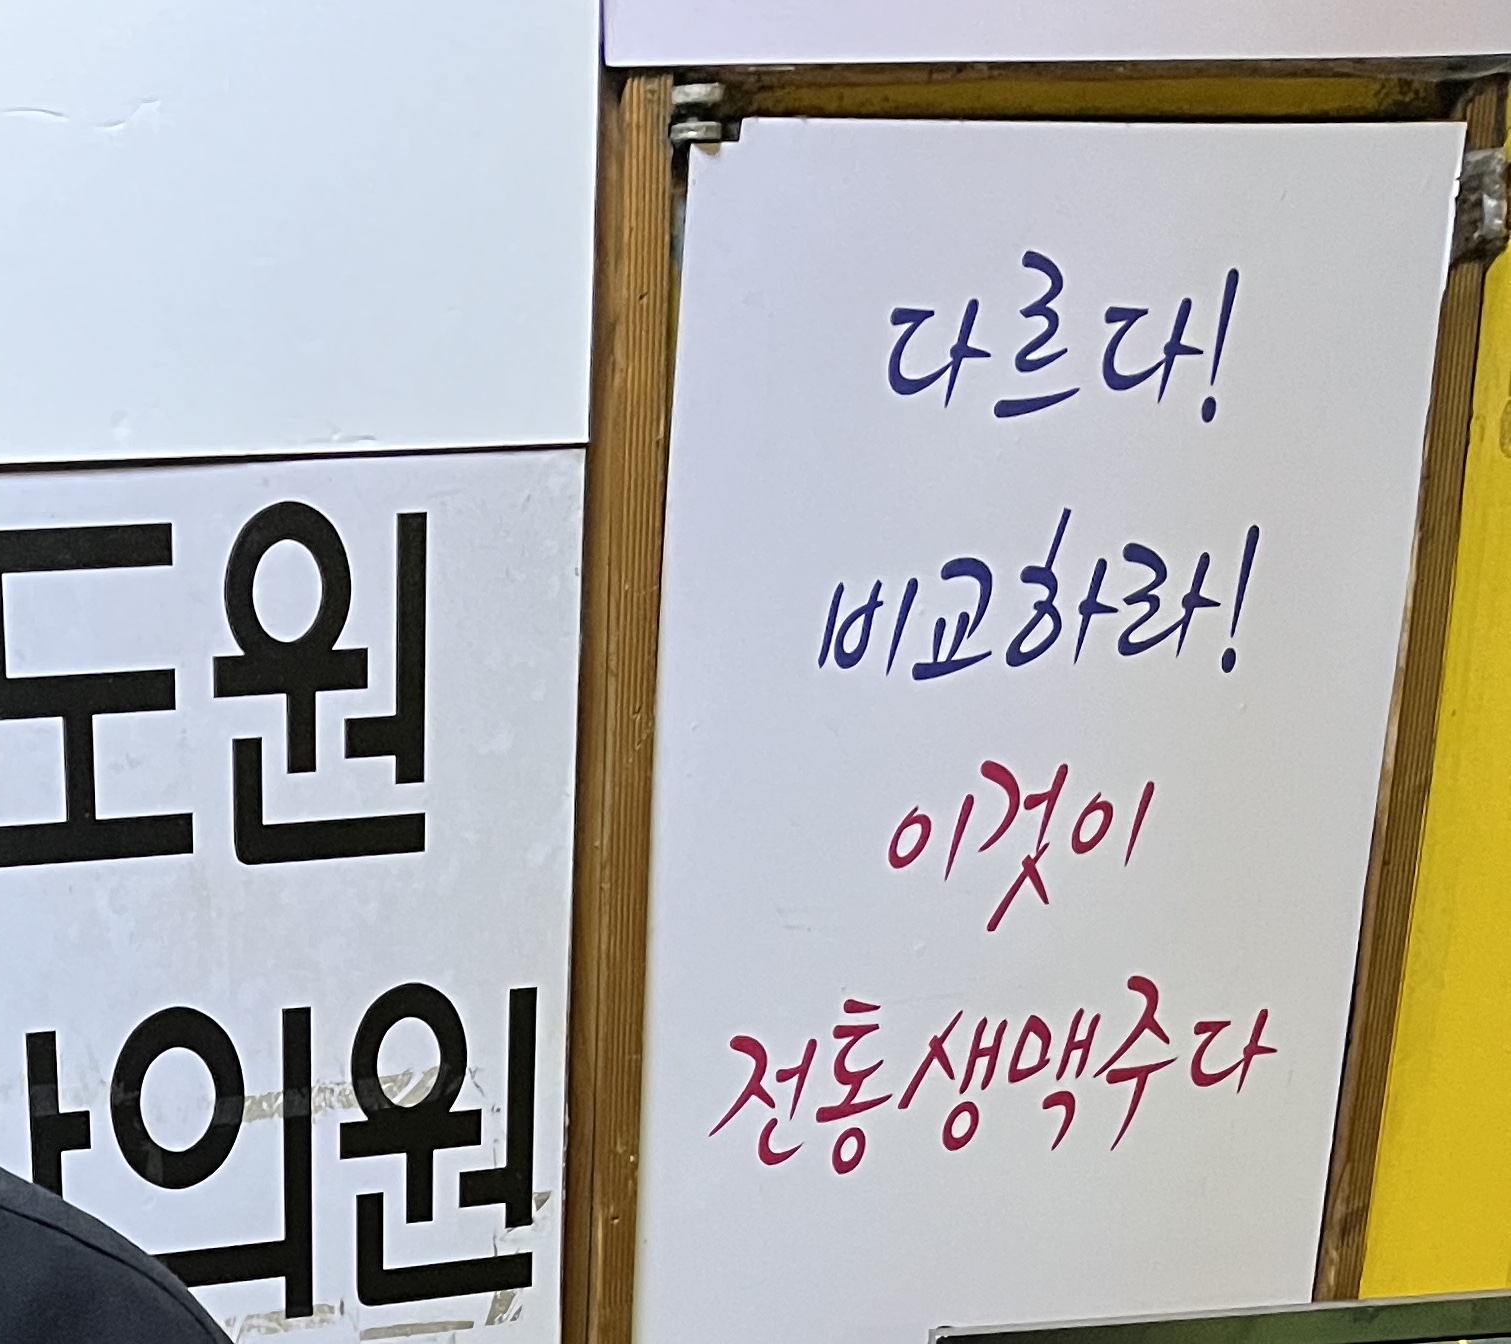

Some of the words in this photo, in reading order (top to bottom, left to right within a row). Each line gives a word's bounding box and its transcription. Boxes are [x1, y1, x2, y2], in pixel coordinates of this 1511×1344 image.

[888, 251, 1239, 422] 다르다!
[818, 508, 1259, 681] 비교하라!
[887, 759, 1155, 932] 이것이
